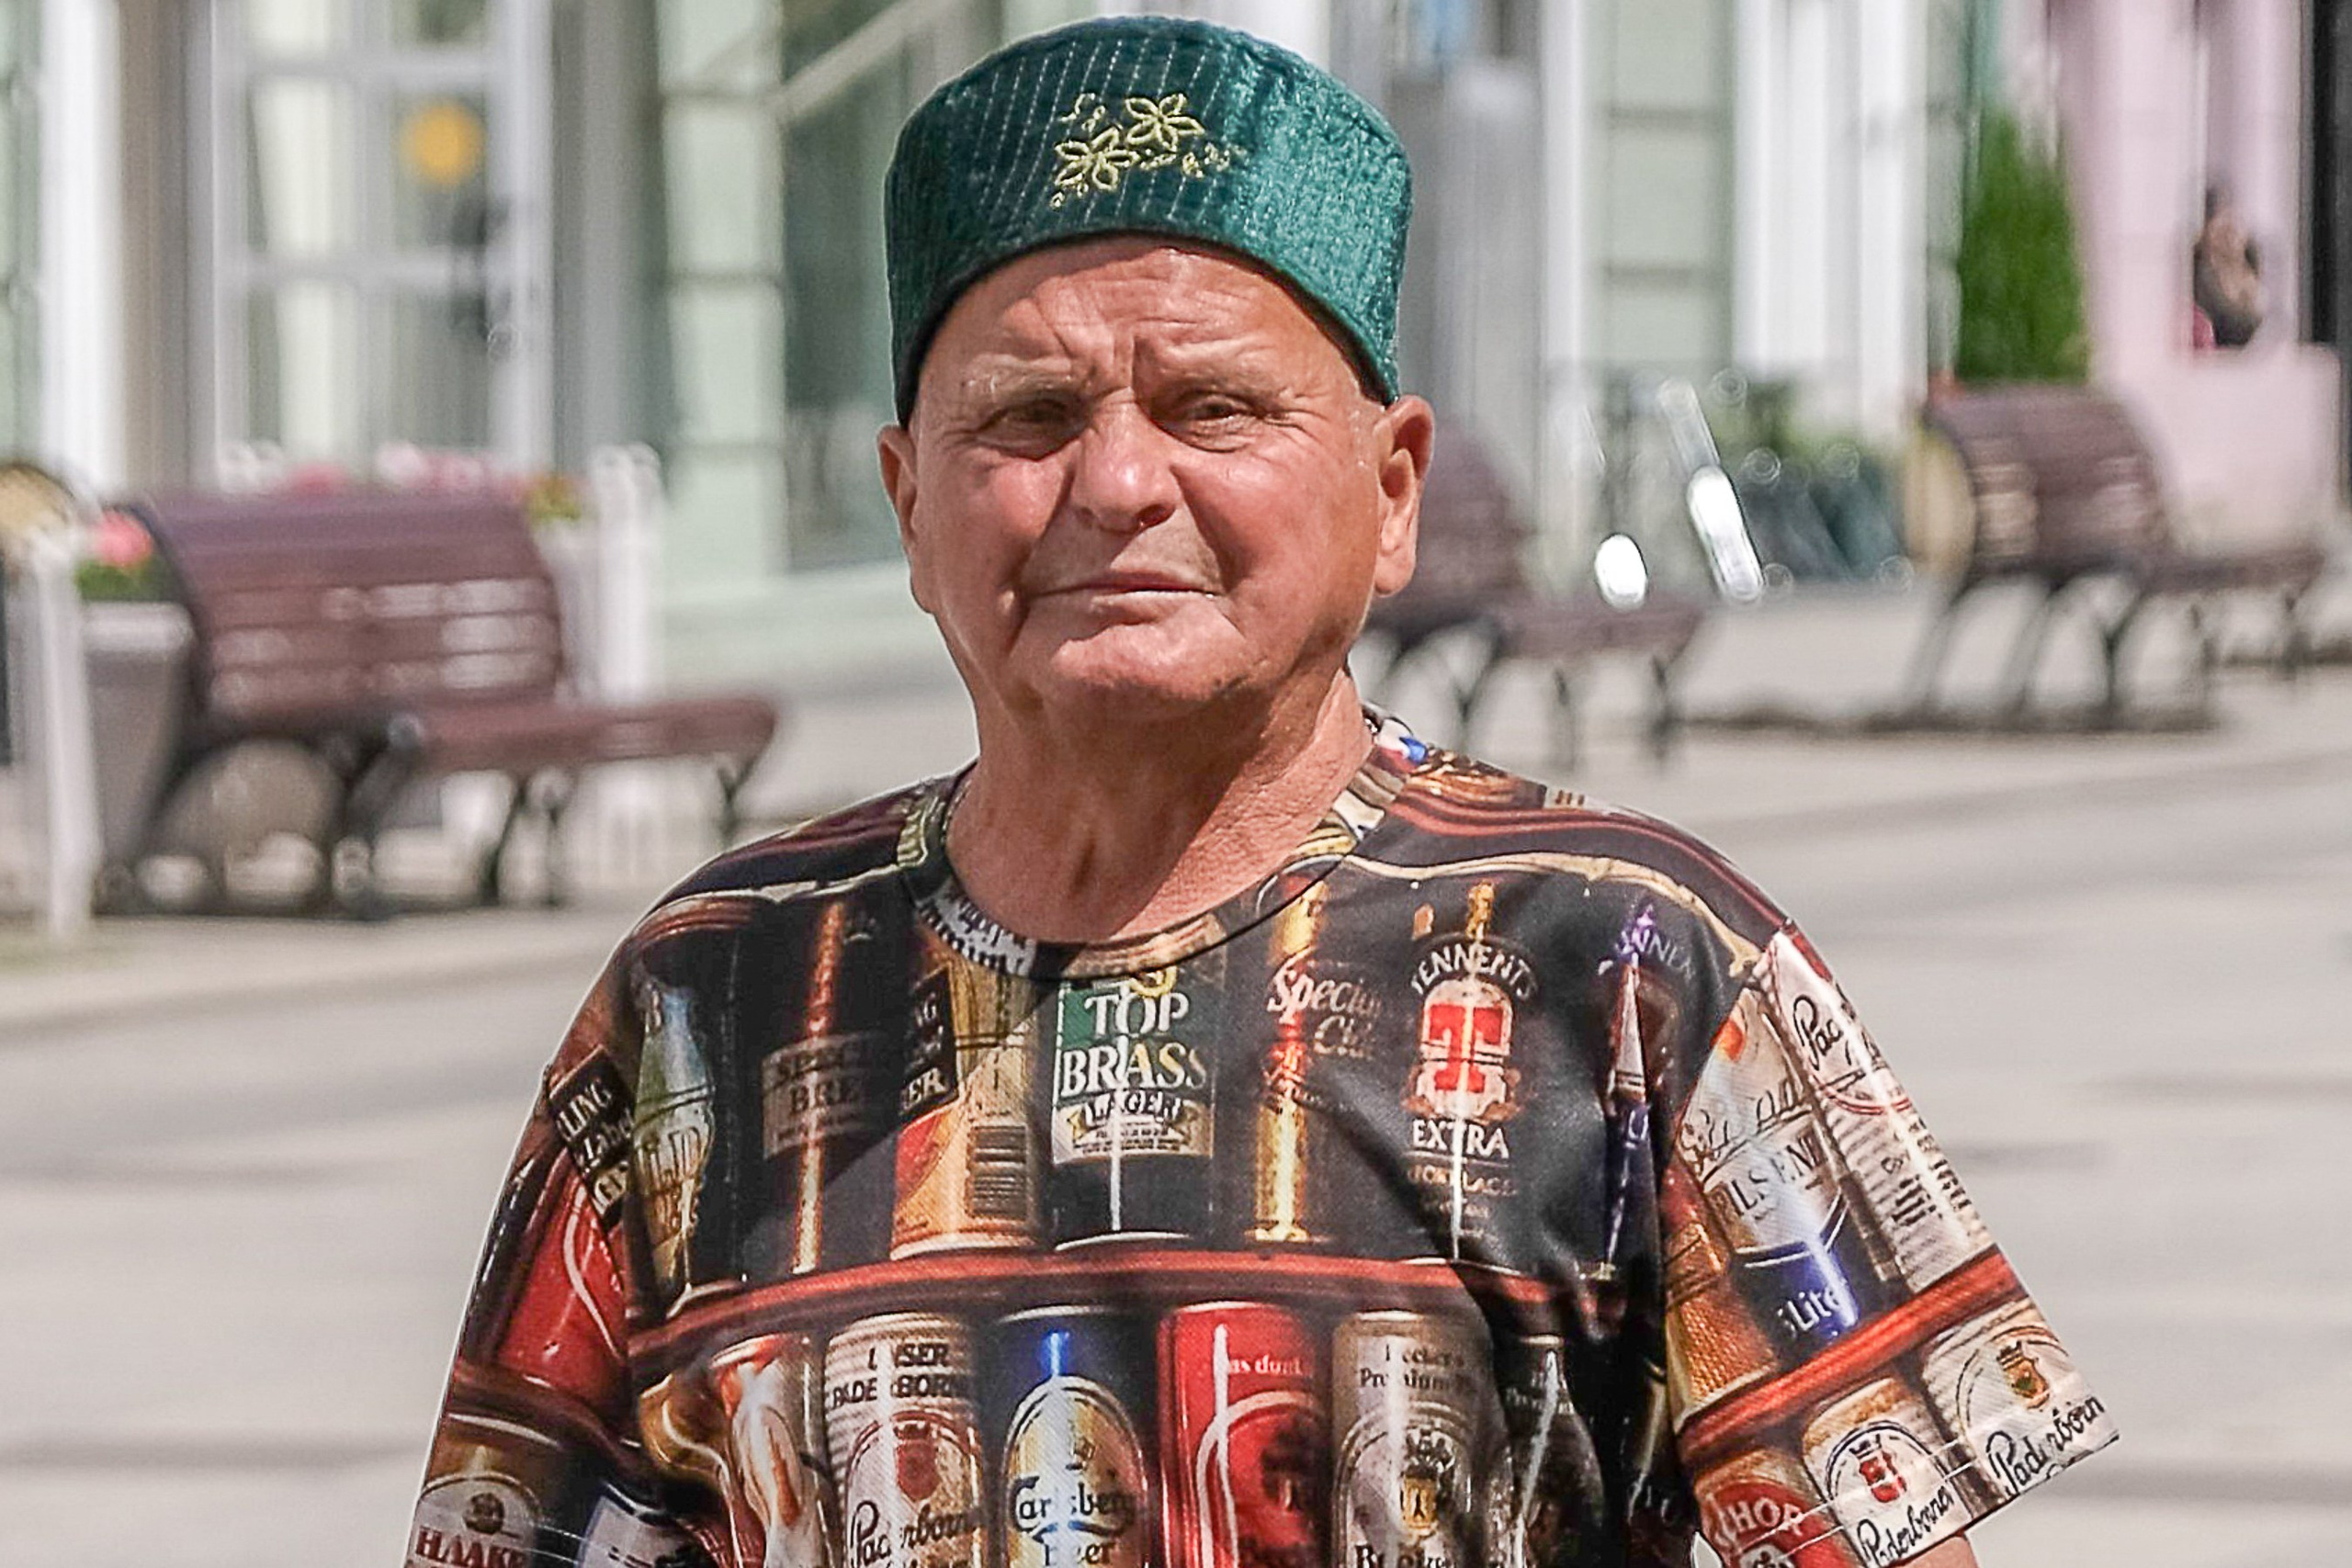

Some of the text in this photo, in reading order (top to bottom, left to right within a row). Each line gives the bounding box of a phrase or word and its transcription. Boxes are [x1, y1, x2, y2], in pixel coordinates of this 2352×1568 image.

[1084, 991, 1190, 1036] TOP
[1060, 1042, 1207, 1098] BRASS
[1412, 1119, 1510, 1159] EXTRA
